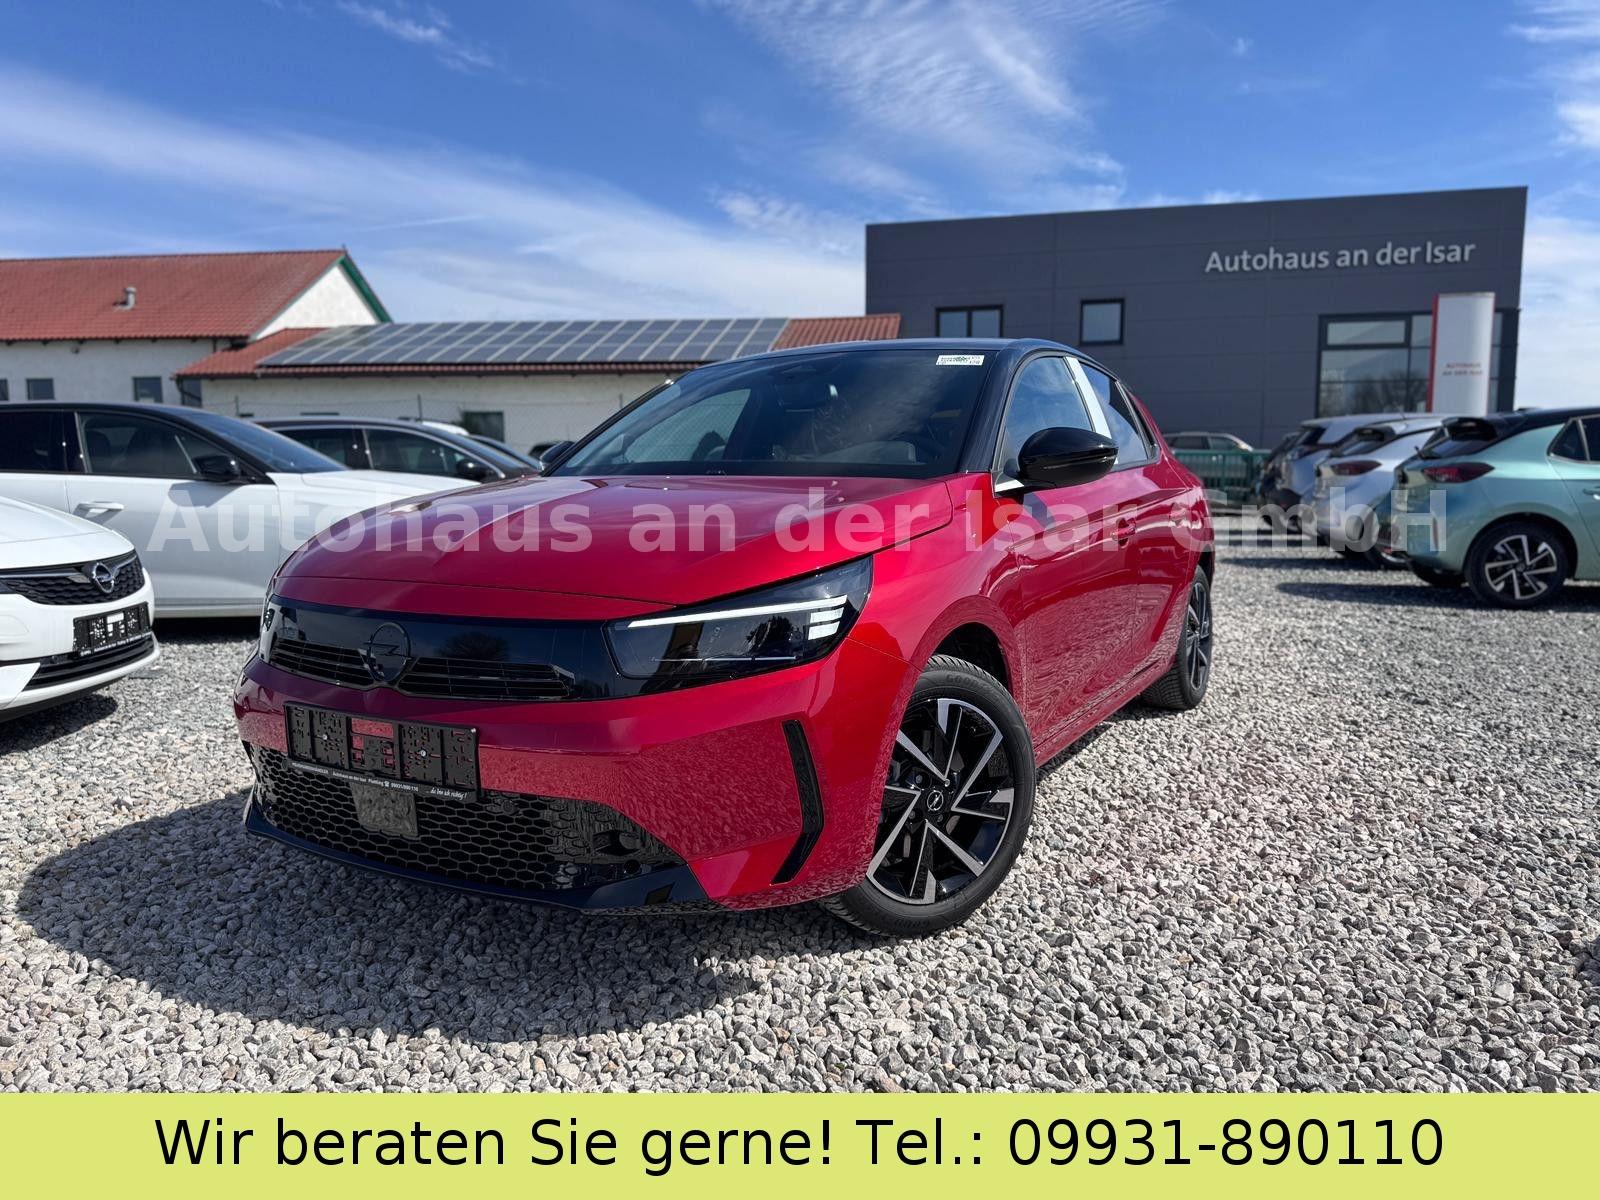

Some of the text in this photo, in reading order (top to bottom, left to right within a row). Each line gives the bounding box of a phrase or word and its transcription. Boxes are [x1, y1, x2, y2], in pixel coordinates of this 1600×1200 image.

[1205, 241, 1476, 273] Autohaus an der Isar
